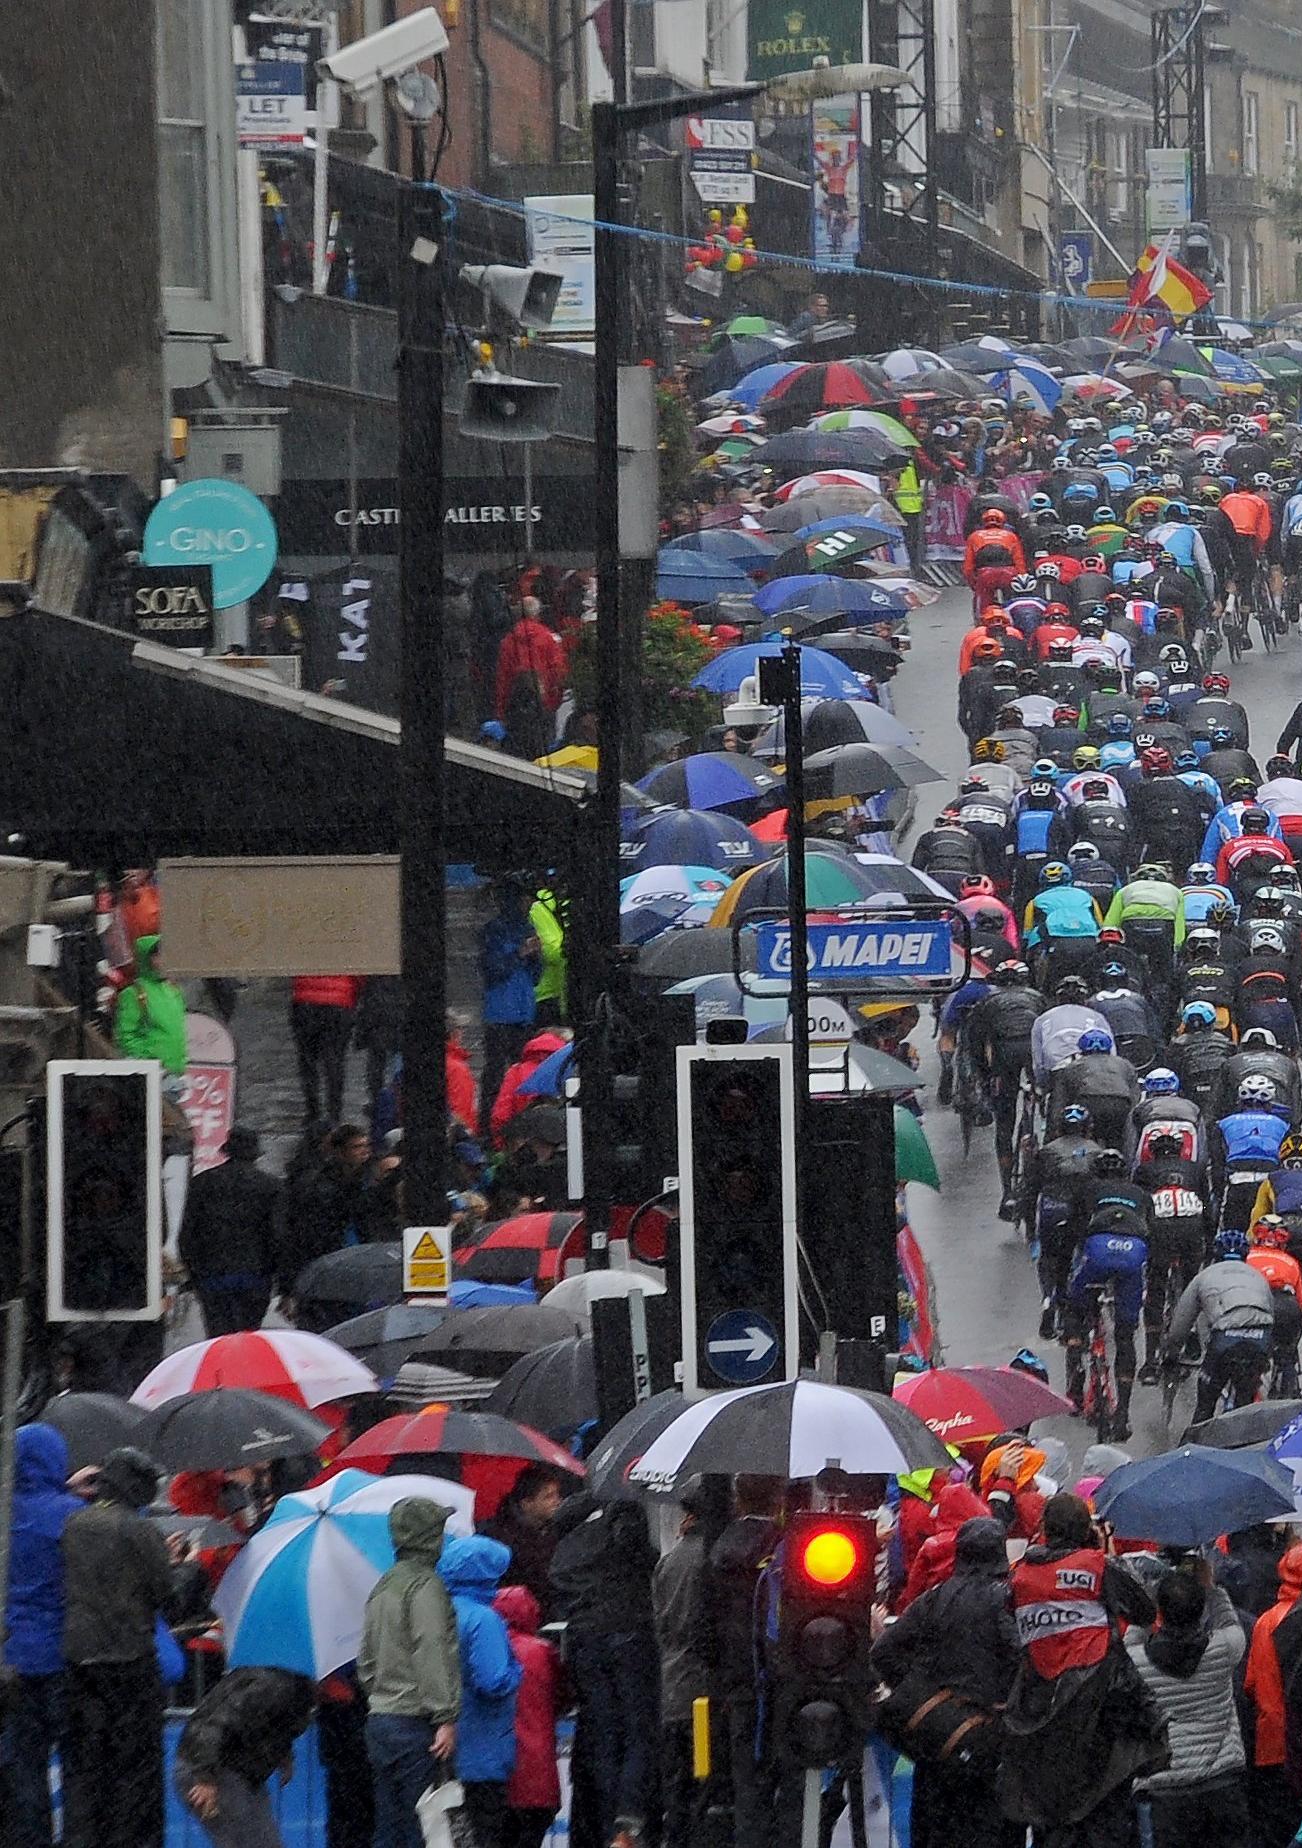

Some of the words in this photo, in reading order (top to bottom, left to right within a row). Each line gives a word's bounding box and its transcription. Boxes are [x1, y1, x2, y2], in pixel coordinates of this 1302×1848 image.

[757, 36, 831, 57] ROLEX
[249, 98, 288, 114] LET
[334, 509, 400, 525] CAST
[443, 505, 542, 524] ALLERES
[169, 527, 249, 552] GINO
[135, 586, 208, 615] SOFA
[820, 932, 933, 968] MAPEI
[807, 1016, 850, 1033] 00M
[925, 1409, 974, 1435] Rapha
